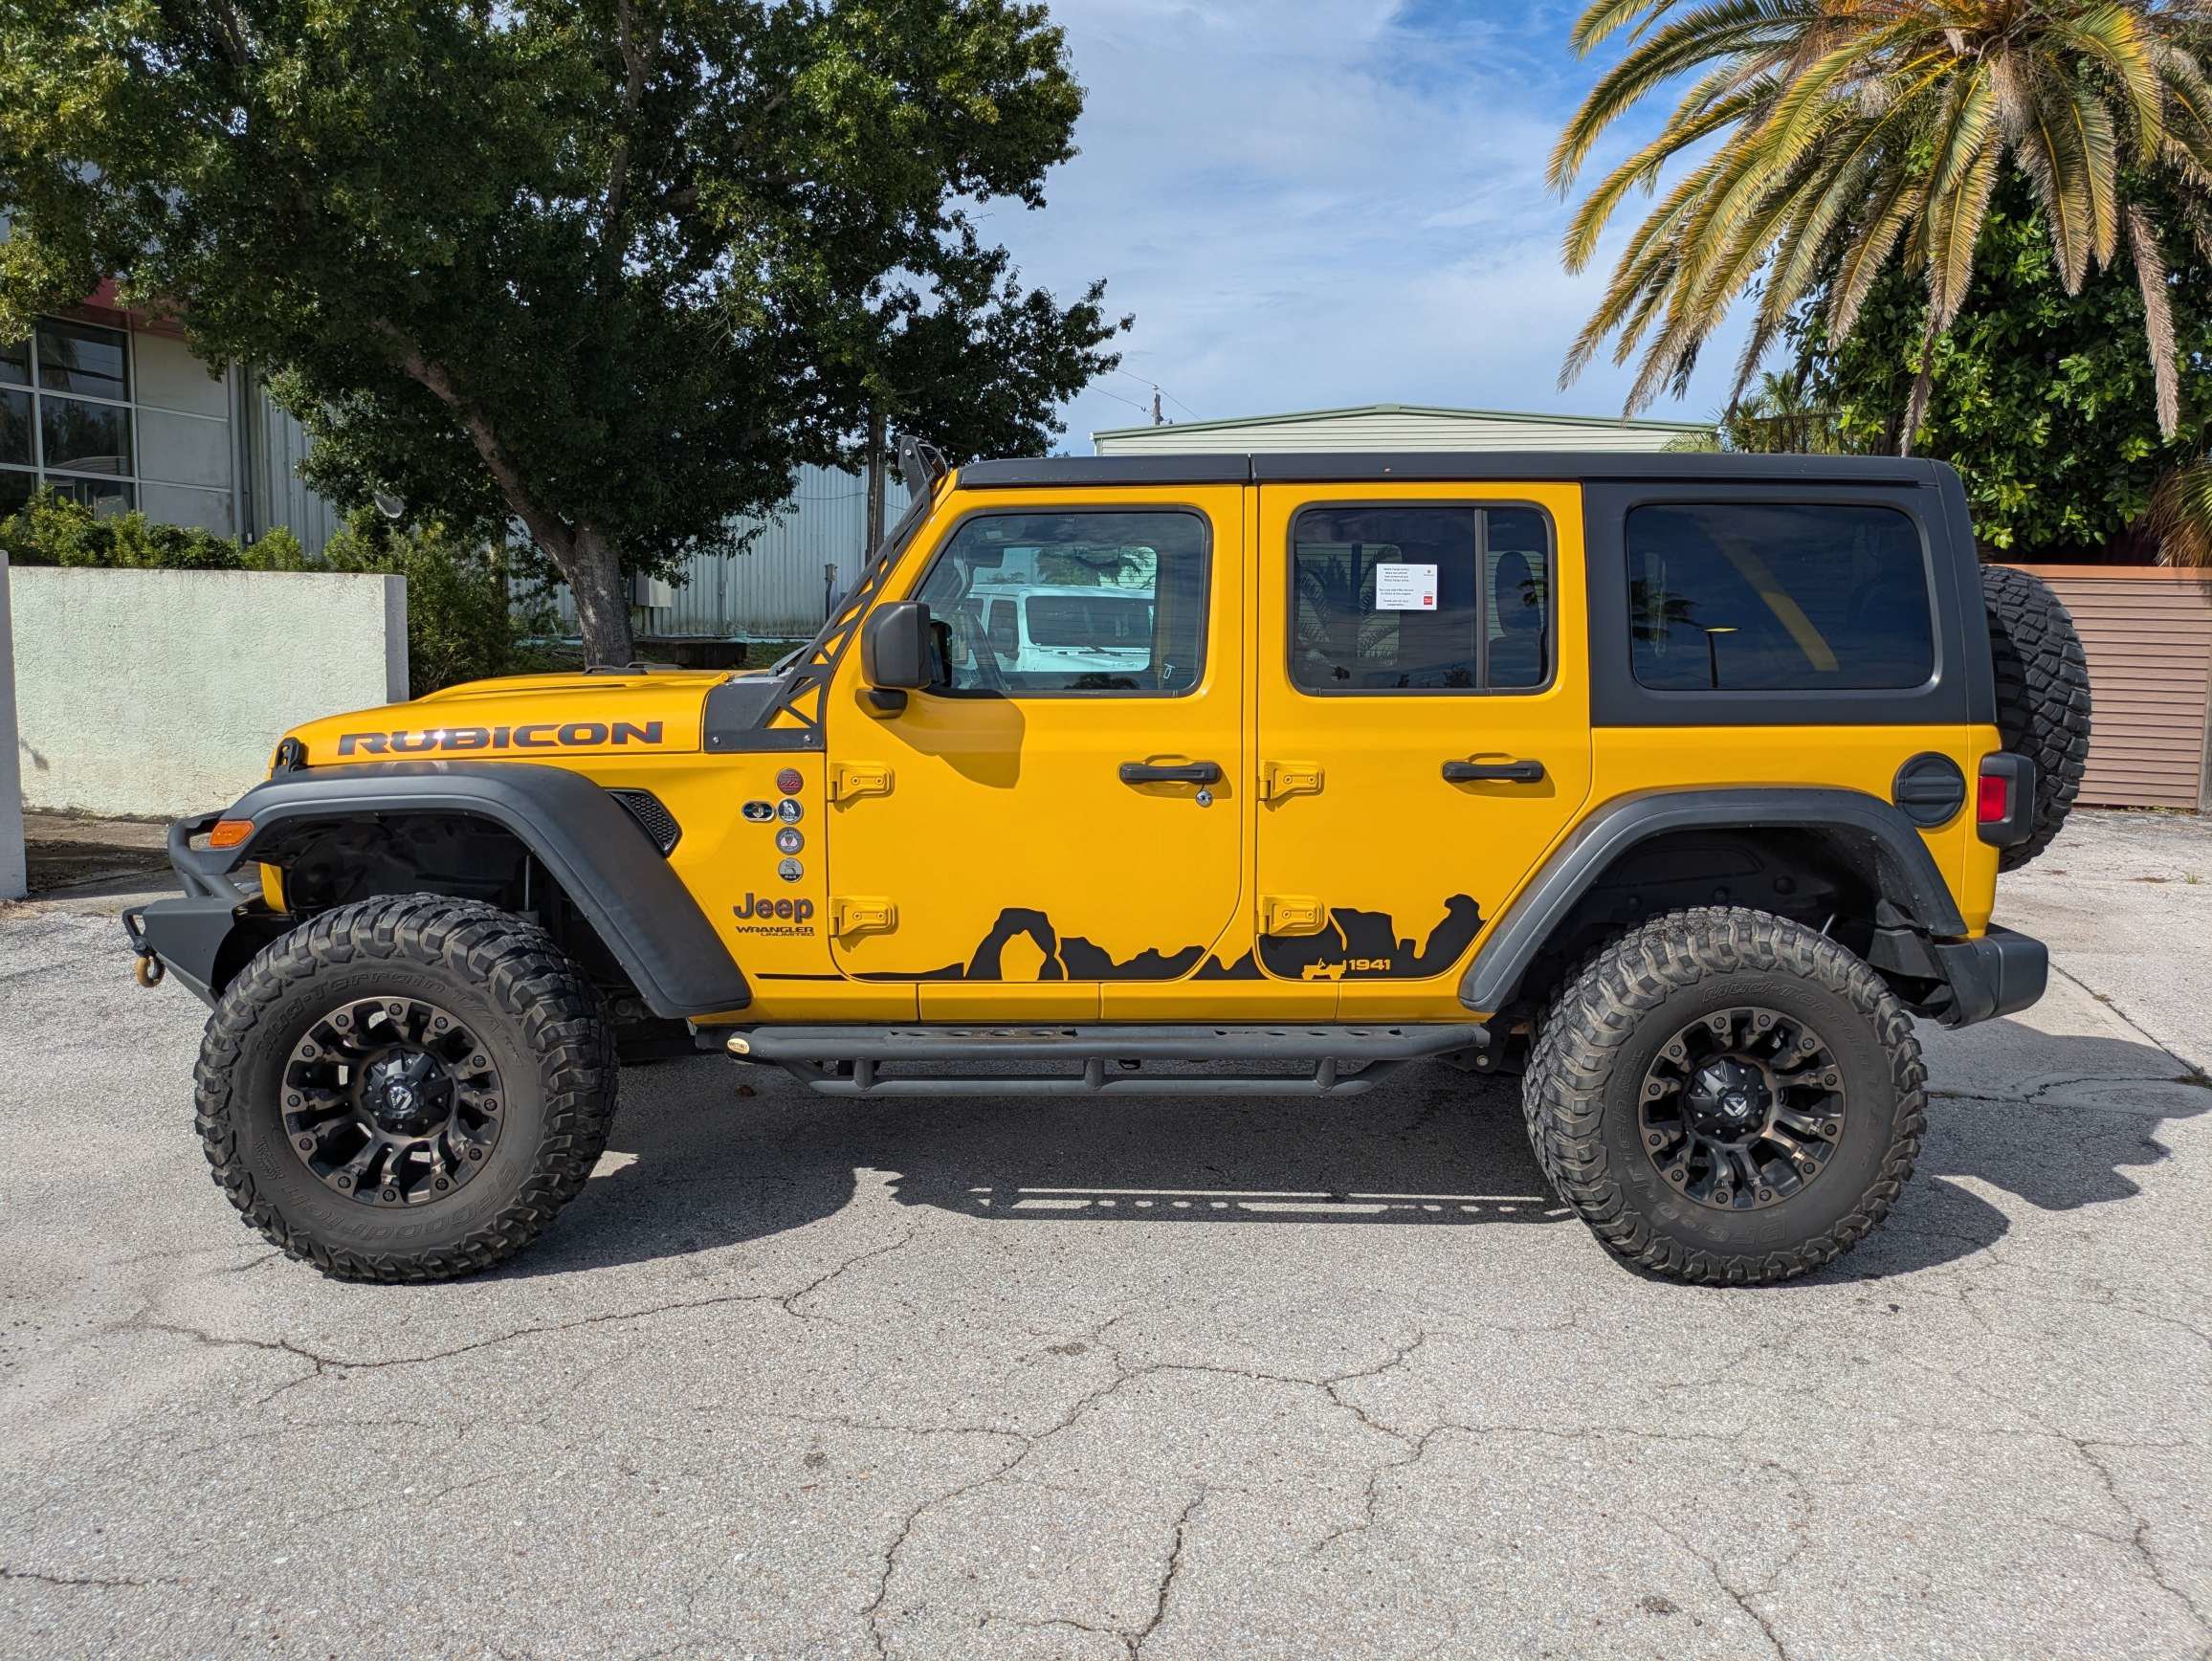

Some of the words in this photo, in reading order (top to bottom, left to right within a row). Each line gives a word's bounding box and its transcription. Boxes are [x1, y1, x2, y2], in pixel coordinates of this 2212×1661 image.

[338, 720, 664, 756] RUBICON
[733, 893, 814, 923] Jeep
[1348, 958, 1391, 971] 1941
